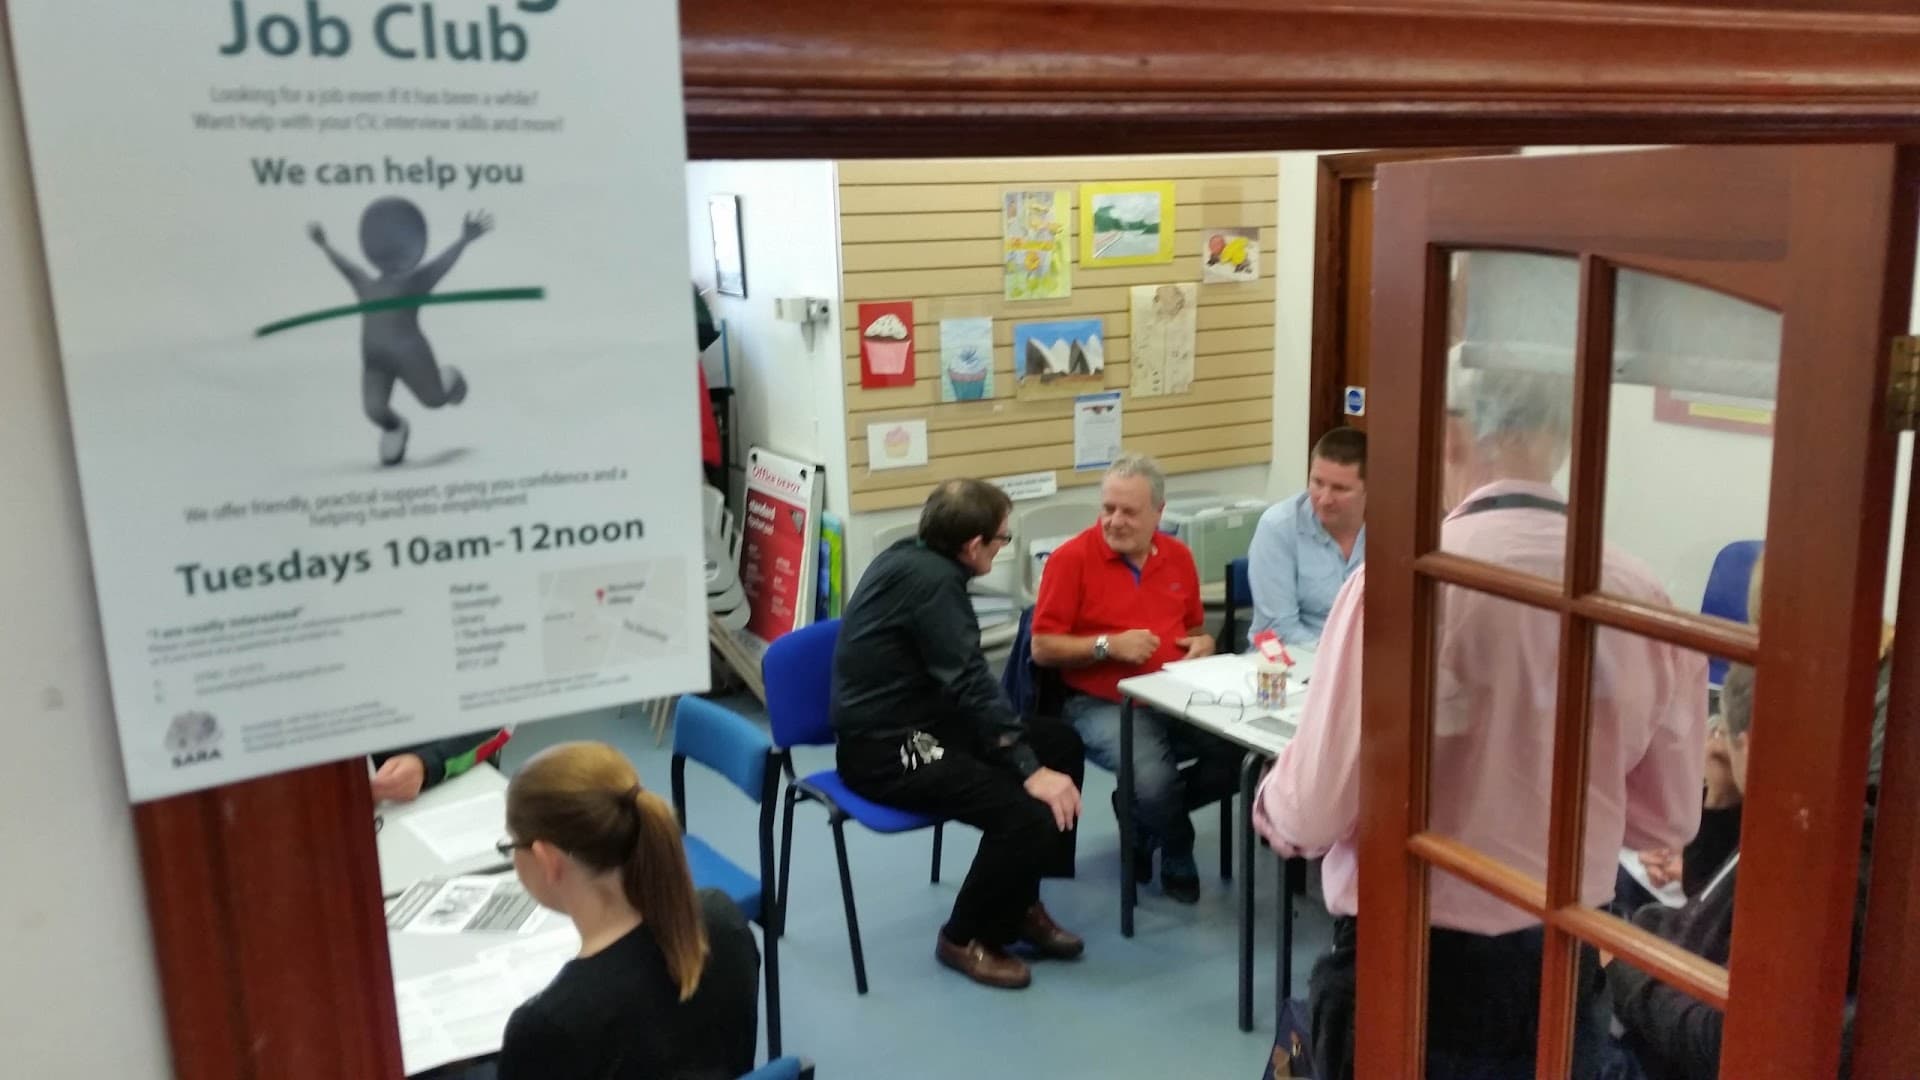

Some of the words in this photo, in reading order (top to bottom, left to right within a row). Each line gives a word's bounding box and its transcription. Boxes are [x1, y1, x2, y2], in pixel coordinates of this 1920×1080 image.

[219, 0, 353, 57] Job
[373, 1, 528, 62] Club
[279, 86, 301, 103] for
[318, 87, 343, 107] job
[250, 157, 306, 185] We
[315, 162, 375, 185] can
[383, 155, 457, 191] help
[465, 162, 525, 190] you
[183, 505, 208, 524] We
[212, 501, 247, 522] offer
[315, 490, 378, 511] practical
[445, 480, 487, 499] giving
[491, 480, 515, 497] you
[518, 470, 590, 489] confidence
[593, 467, 618, 482] and
[619, 469, 628, 480] a
[309, 508, 367, 528] helping
[368, 503, 407, 520] hand
[410, 501, 438, 516] into
[442, 493, 528, 514] employment
[175, 547, 371, 597] Tuesdays
[384, 518, 645, 568] 10am-12noon
